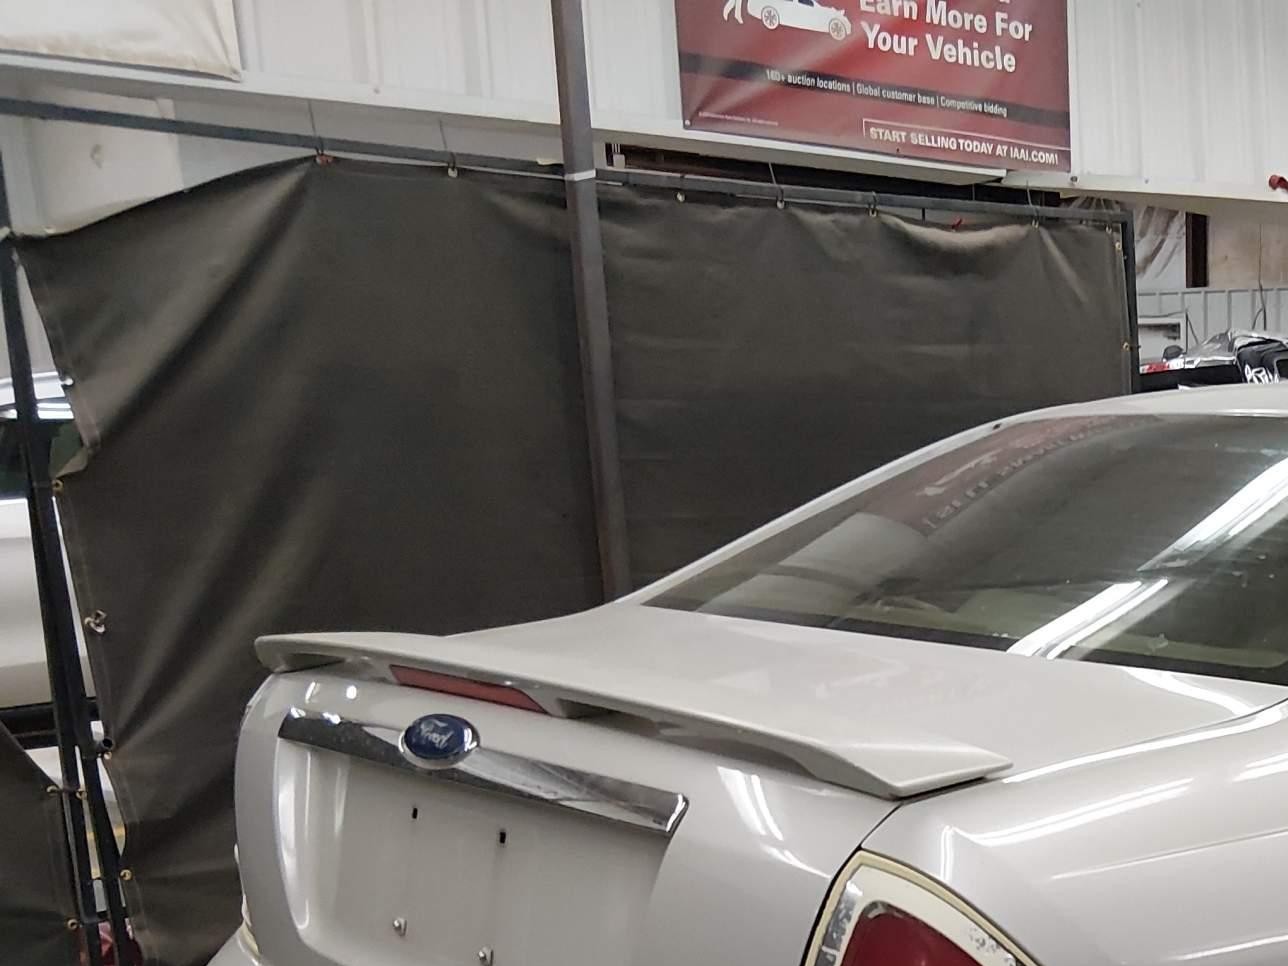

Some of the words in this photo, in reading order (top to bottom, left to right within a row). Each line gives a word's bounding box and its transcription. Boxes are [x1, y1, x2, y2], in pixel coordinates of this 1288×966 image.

[926, 0, 987, 33] More
[995, 11, 1033, 41] For
[861, 21, 918, 56] Your
[925, 34, 1016, 72] Vehicle
[787, 74, 815, 87] auction
[816, 77, 851, 93] locations
[857, 83, 880, 97] Global
[882, 88, 916, 103] customer
[917, 92, 935, 105] base
[940, 96, 983, 112] Competitive
[984, 102, 1007, 118] bidding
[870, 127, 907, 143] START
[911, 133, 957, 150] SELLING
[958, 139, 993, 155] TODAY
[995, 145, 1009, 157] AT
